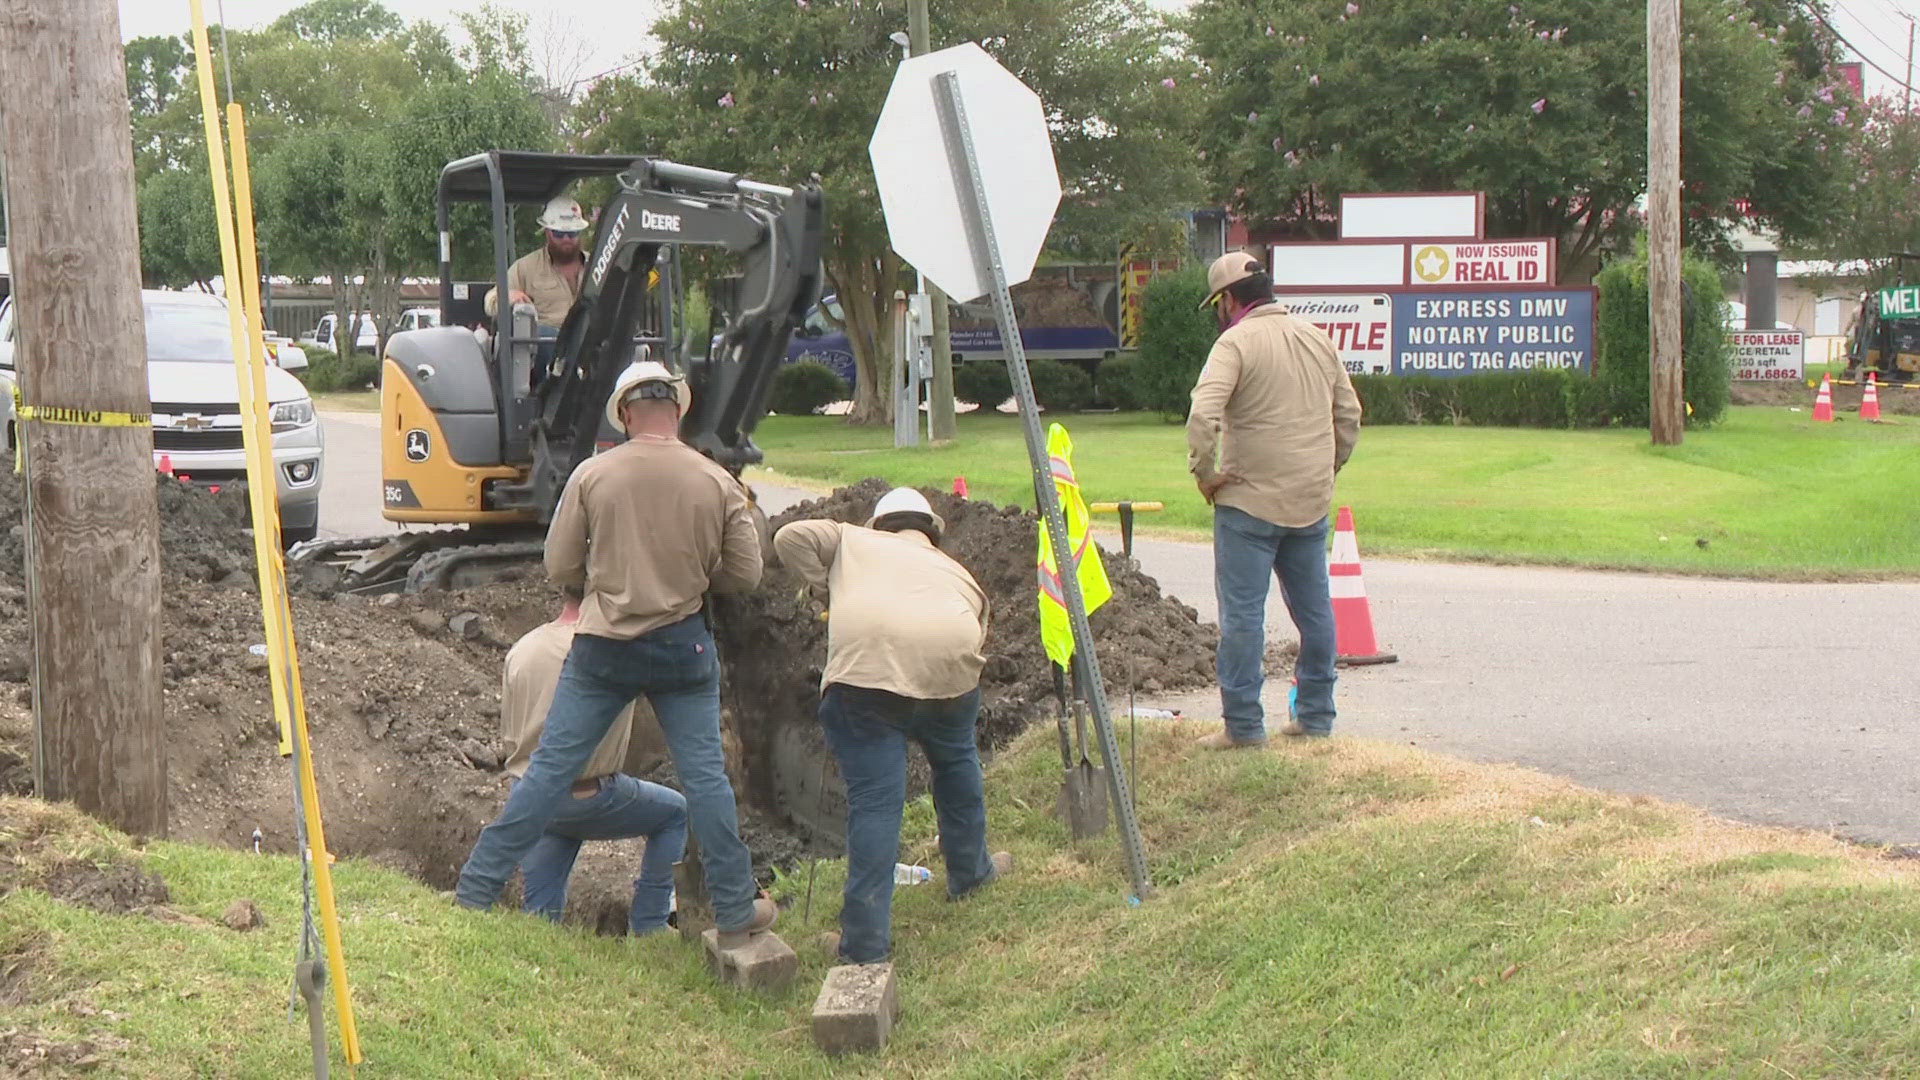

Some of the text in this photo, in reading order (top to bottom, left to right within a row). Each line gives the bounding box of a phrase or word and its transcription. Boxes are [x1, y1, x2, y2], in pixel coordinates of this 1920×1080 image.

[641, 208, 681, 232] DEERE
[591, 203, 630, 287] DOGGETT
[1455, 245, 1538, 259] NOW ISSUING
[1455, 260, 1538, 282] REAL ID
[1416, 298, 1567, 318] EXPRESS DMV
[1408, 325, 1575, 345] NOTARY PUBLIC
[1743, 334, 1764, 346] FOR
[1767, 334, 1800, 345] LEASE
[1401, 351, 1466, 370] PUBLIC
[1469, 351, 1504, 370] TAG
[1757, 358, 1777, 368] sqft
[385, 485, 402, 502] 35G
